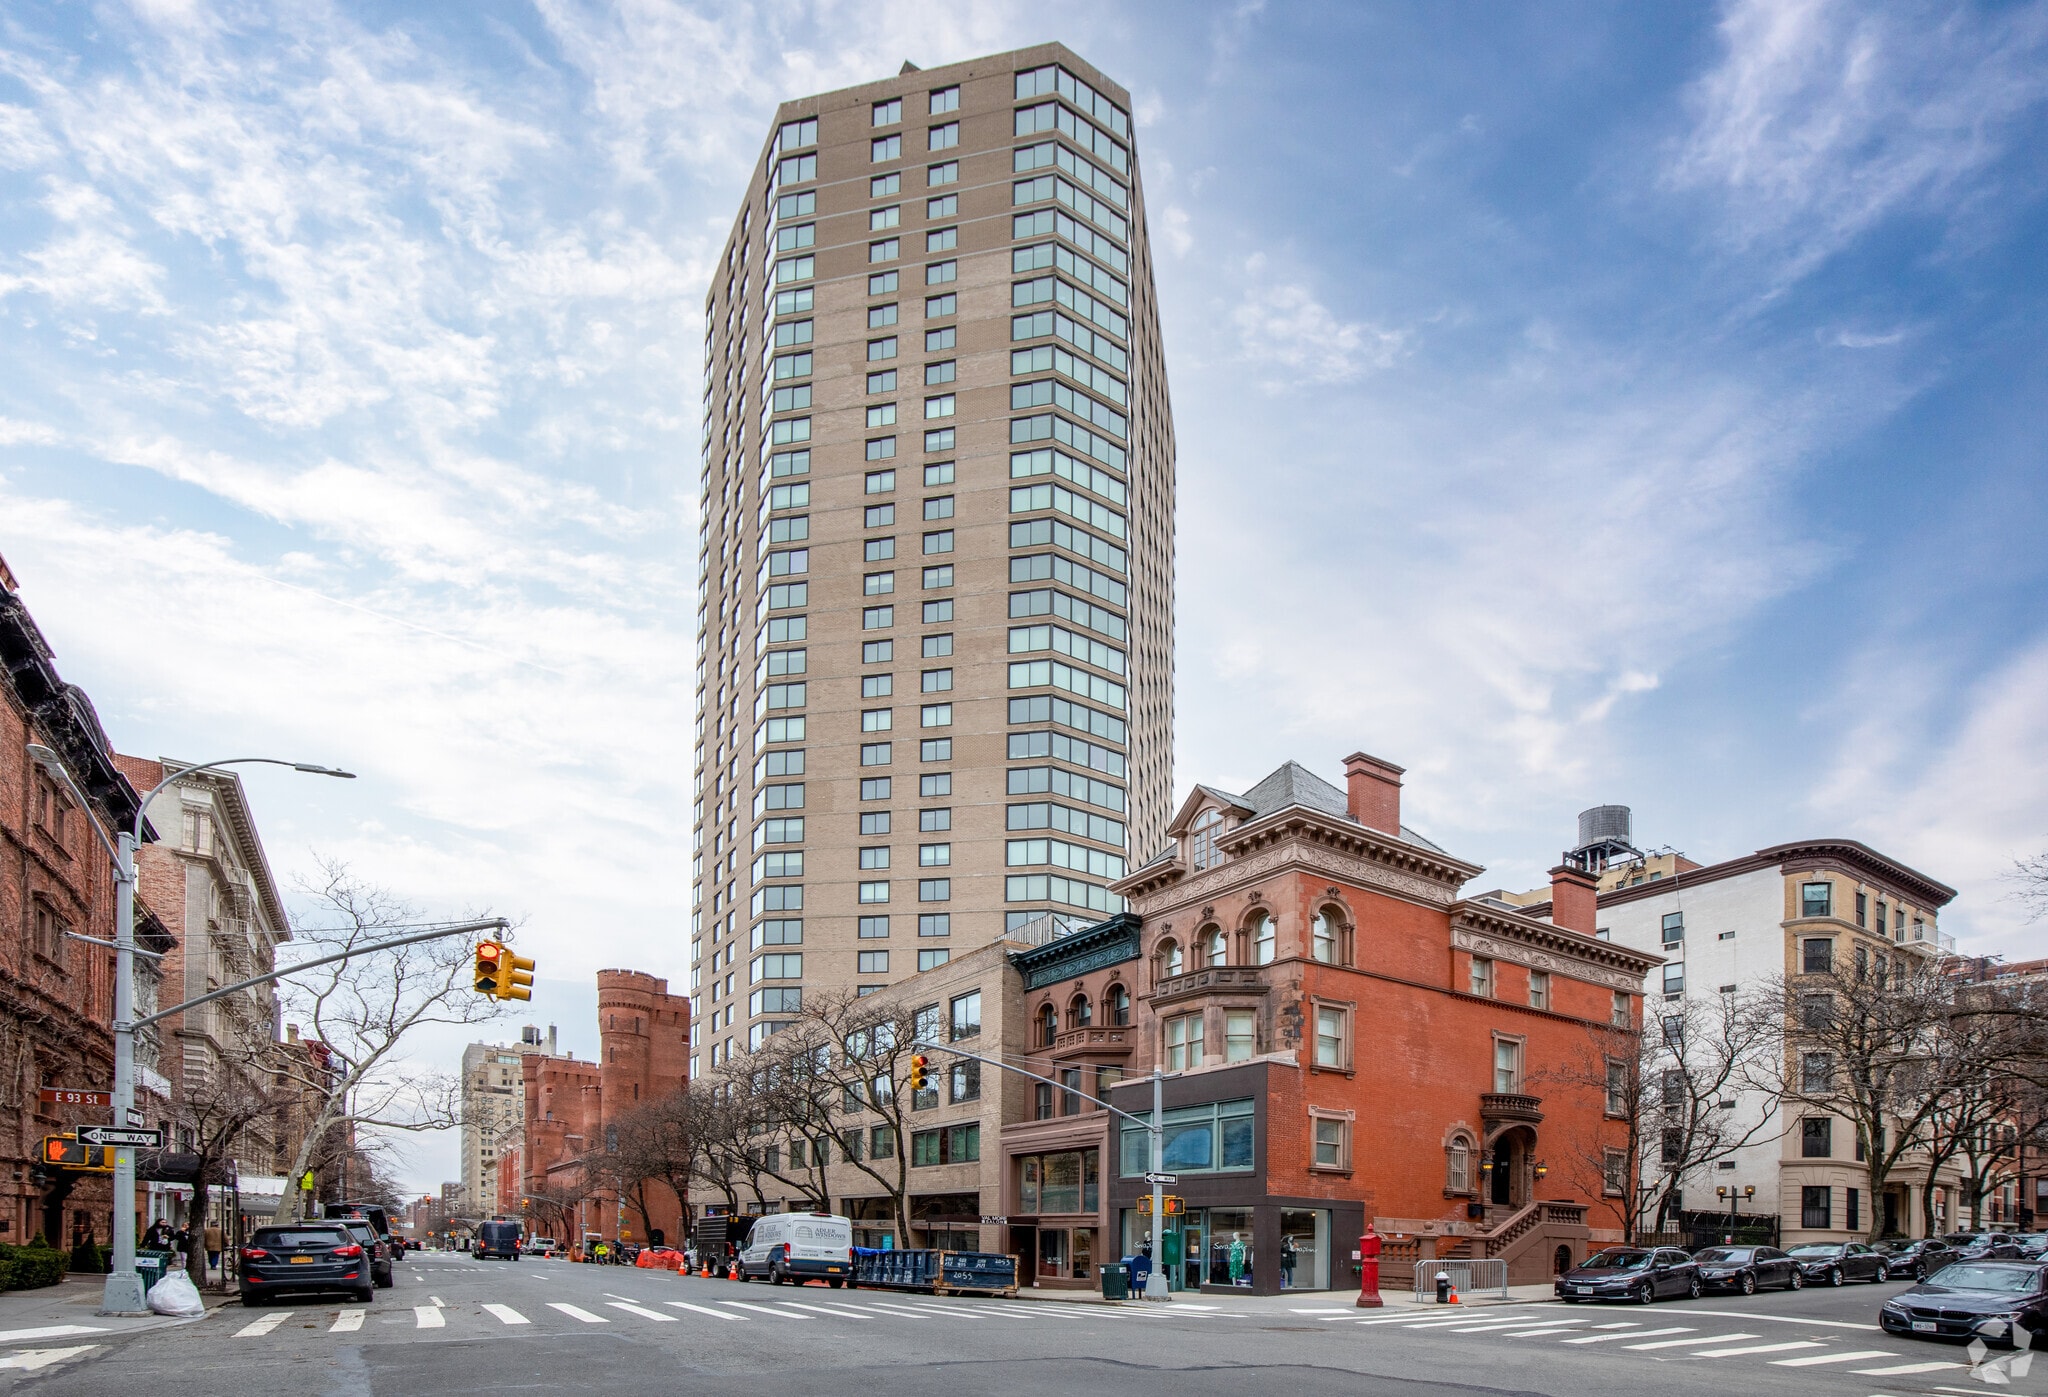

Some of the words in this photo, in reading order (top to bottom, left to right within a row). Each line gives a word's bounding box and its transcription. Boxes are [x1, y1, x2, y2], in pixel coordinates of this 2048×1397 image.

[55, 1092, 62, 1102] E
[67, 1093, 80, 1103] 93
[86, 1094, 98, 1105] St
[90, 1131, 115, 1141] ONE
[126, 1133, 152, 1143] WAY
